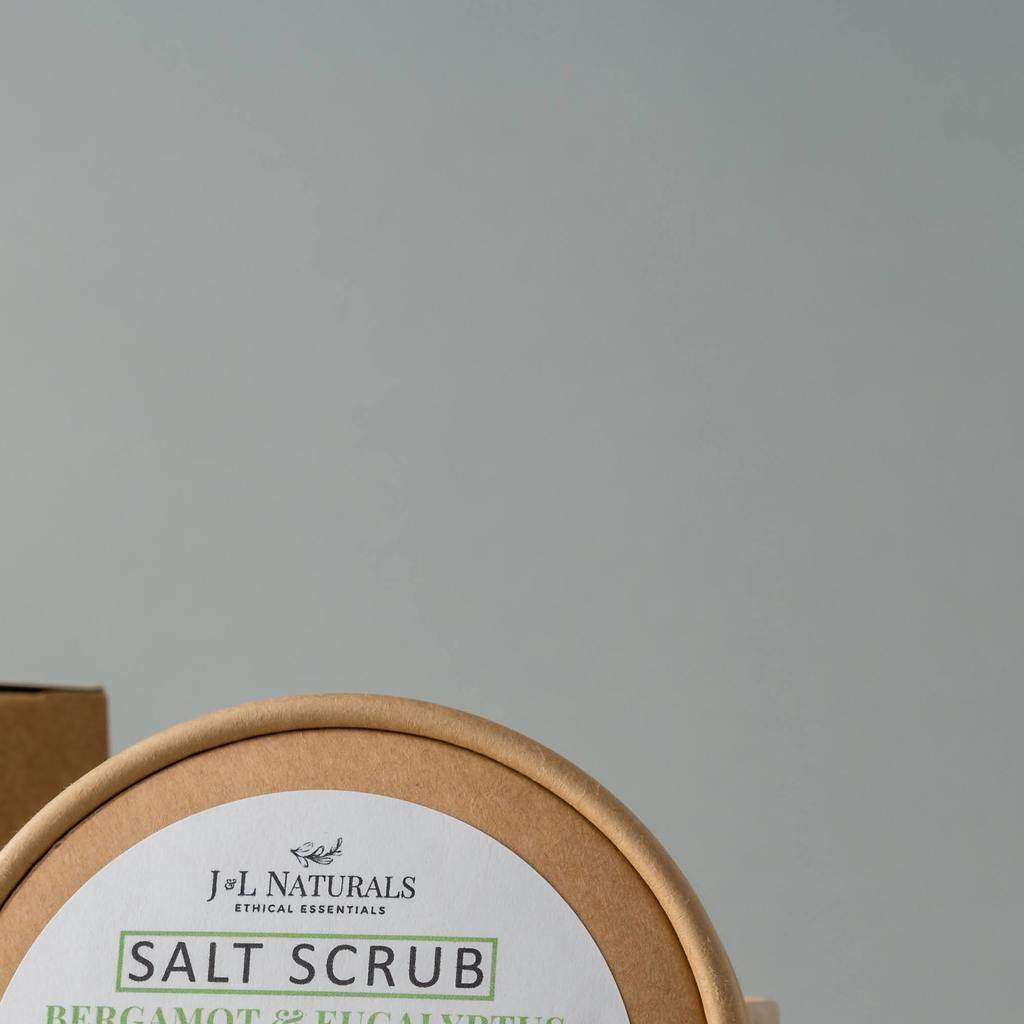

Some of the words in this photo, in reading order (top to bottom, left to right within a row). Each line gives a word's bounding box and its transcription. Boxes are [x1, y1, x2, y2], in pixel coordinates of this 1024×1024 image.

[207, 870, 256, 902] J&L
[266, 871, 415, 899] NATURALS
[235, 904, 293, 913] ETHICAL
[301, 905, 385, 915] ESSENTIALS
[129, 941, 263, 983] SALT
[289, 943, 484, 988] SCRUB
